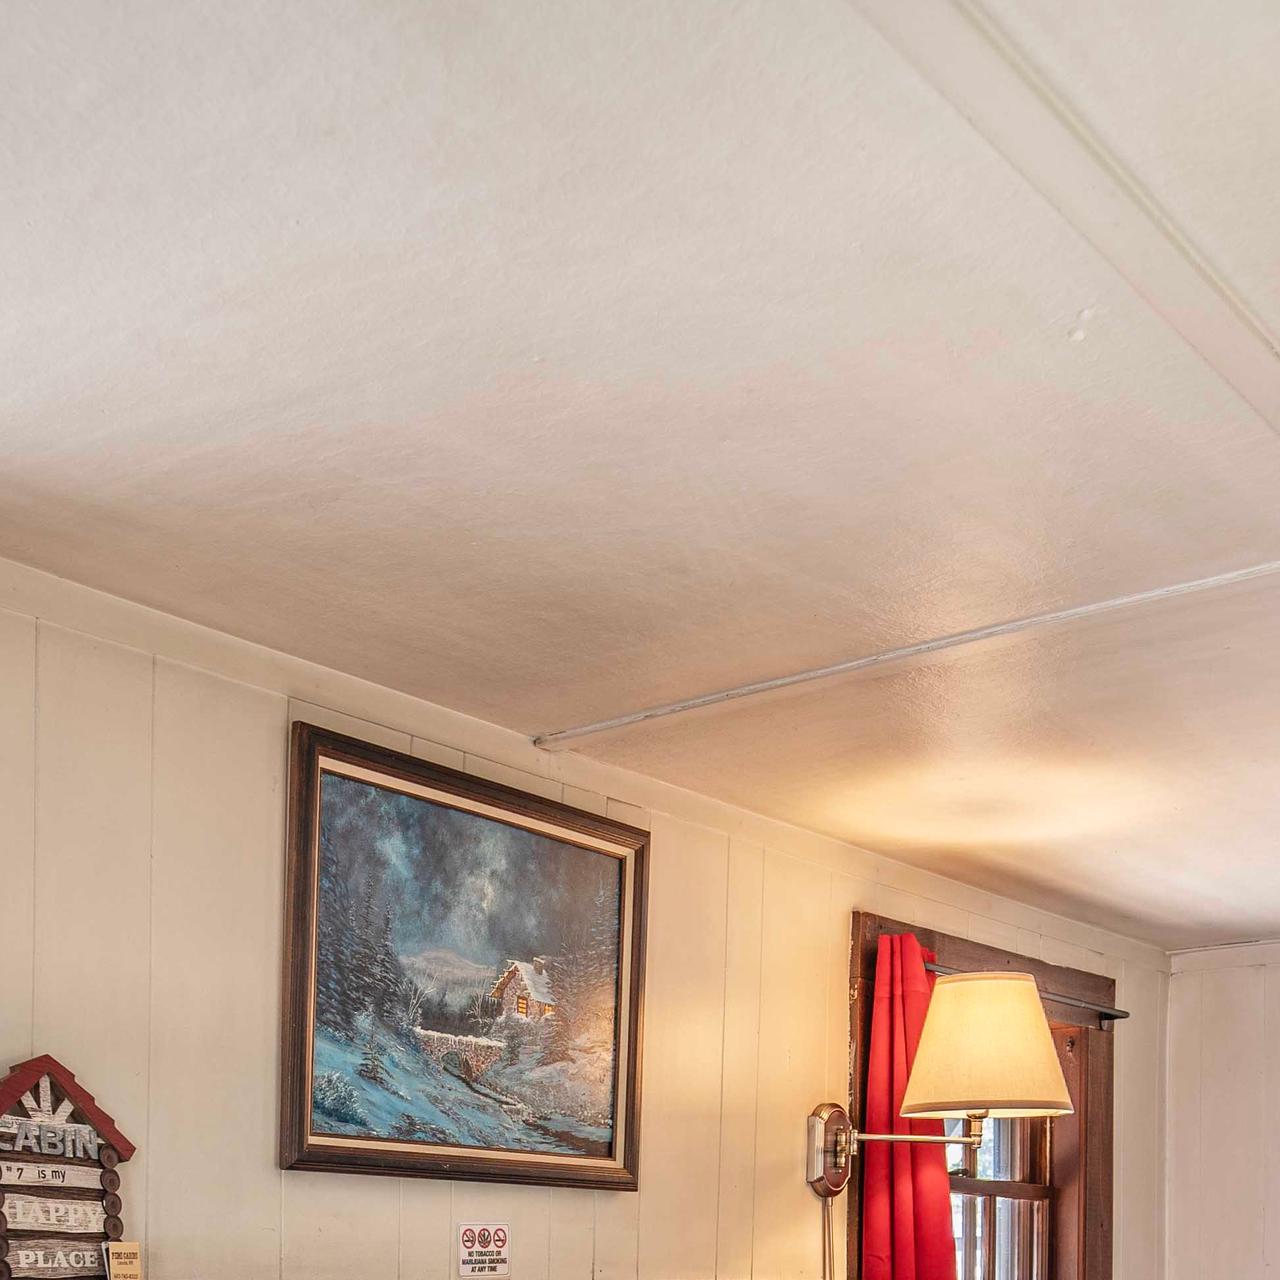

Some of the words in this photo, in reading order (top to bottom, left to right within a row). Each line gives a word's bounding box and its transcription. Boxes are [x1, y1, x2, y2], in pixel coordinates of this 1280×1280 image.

[37, 1166, 47, 1179] is
[51, 1169, 66, 1183] my
[17, 1250, 98, 1268] PLACE
